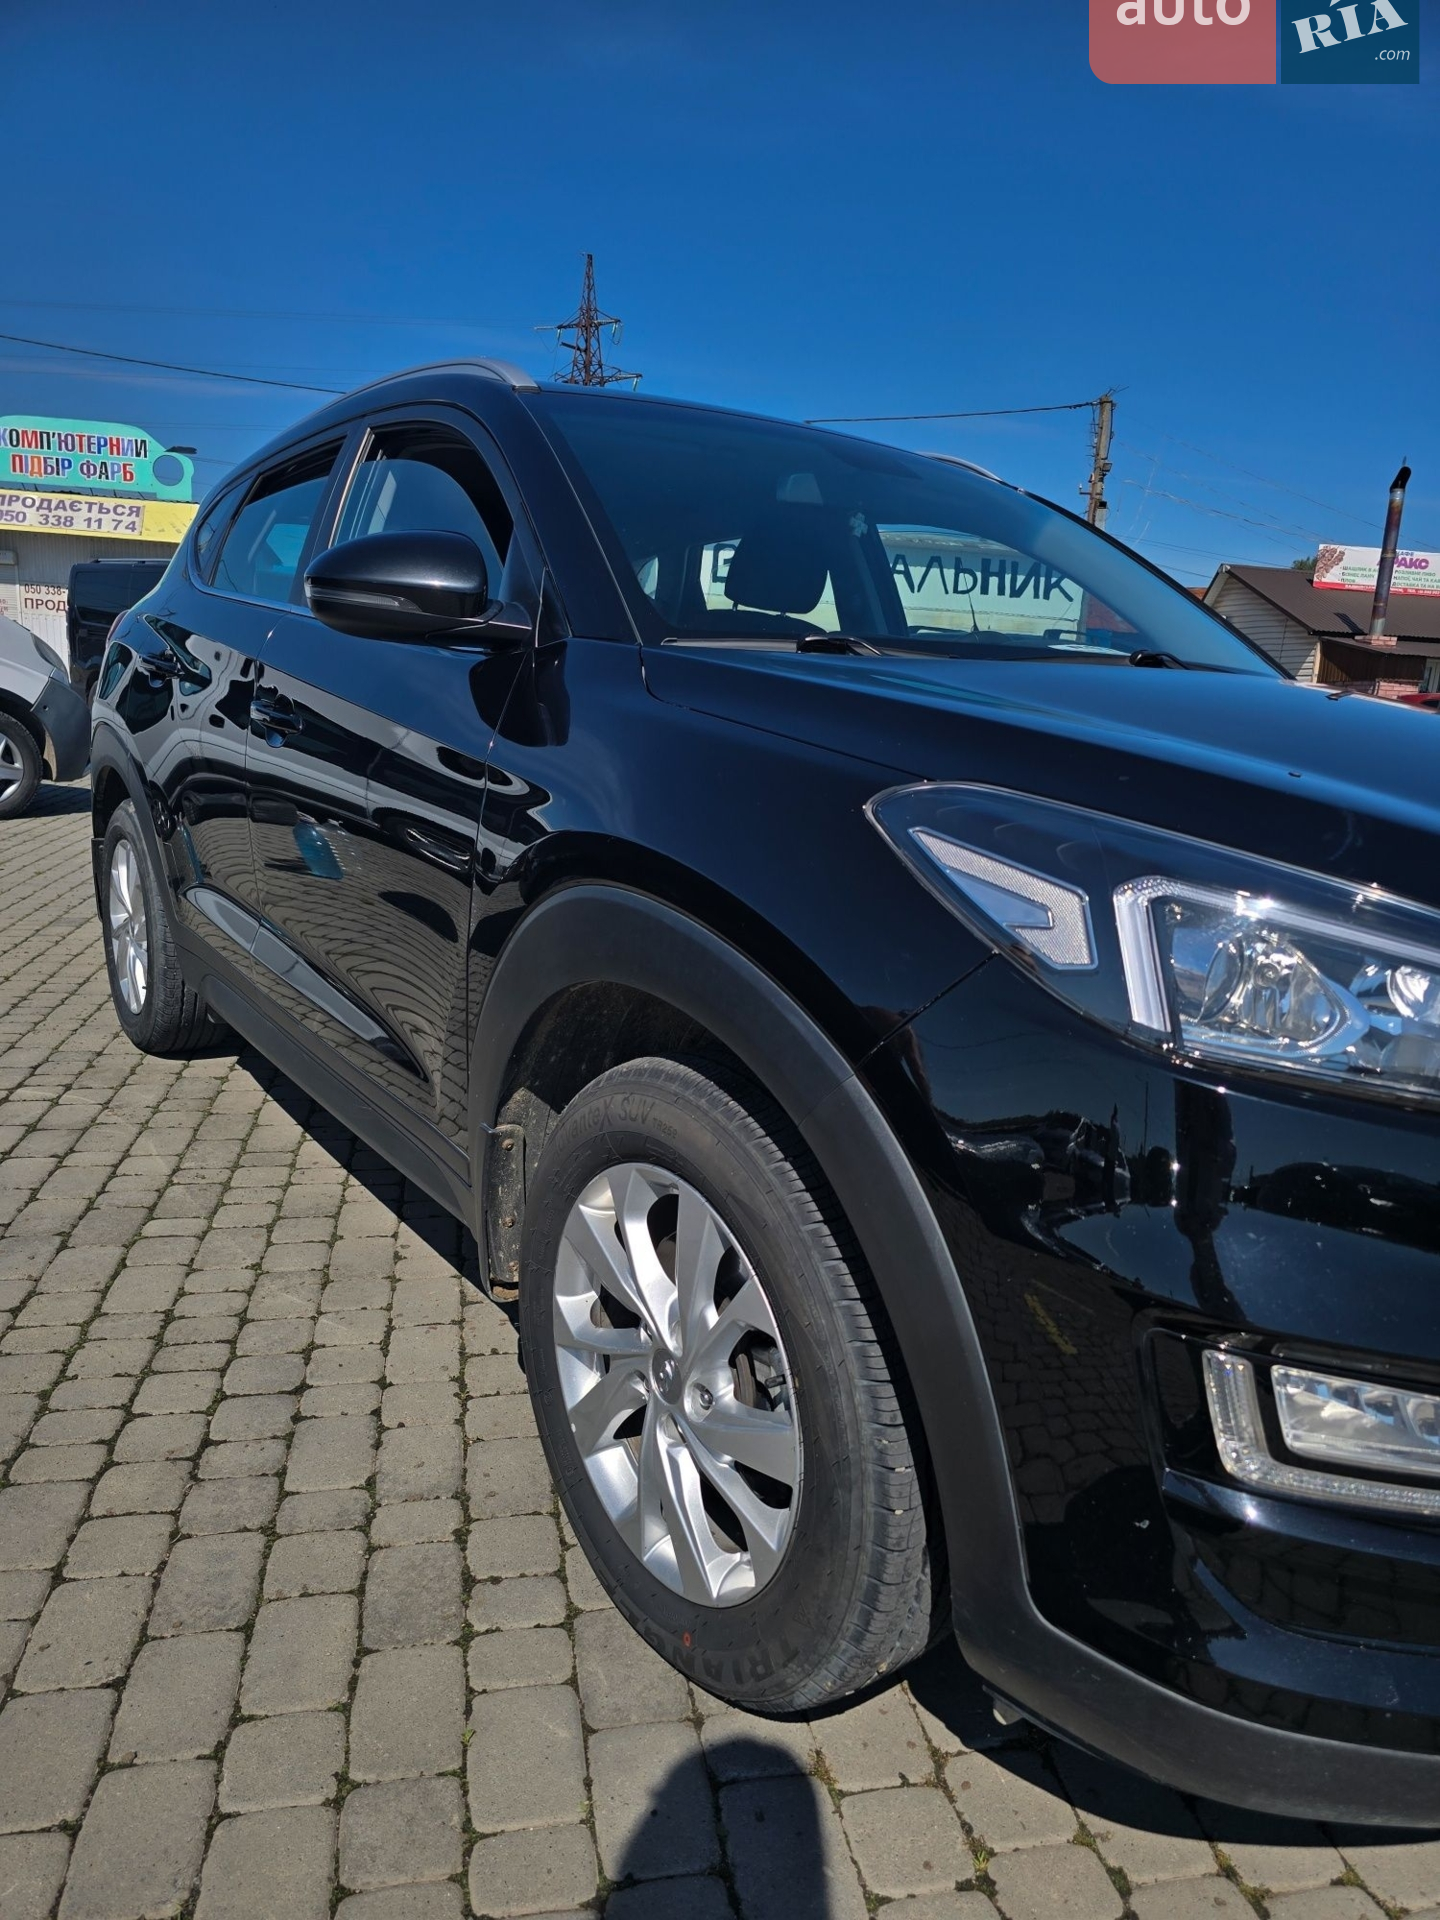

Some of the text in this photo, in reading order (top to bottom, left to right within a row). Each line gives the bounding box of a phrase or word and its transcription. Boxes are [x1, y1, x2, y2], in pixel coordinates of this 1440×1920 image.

[11, 454, 135, 482] ПІДБІР ФАРБ
[38, 513, 74, 528] 338
[83, 516, 103, 530] 11
[24, 583, 68, 596] 050 338-
[24, 597, 67, 613] ПРОД
